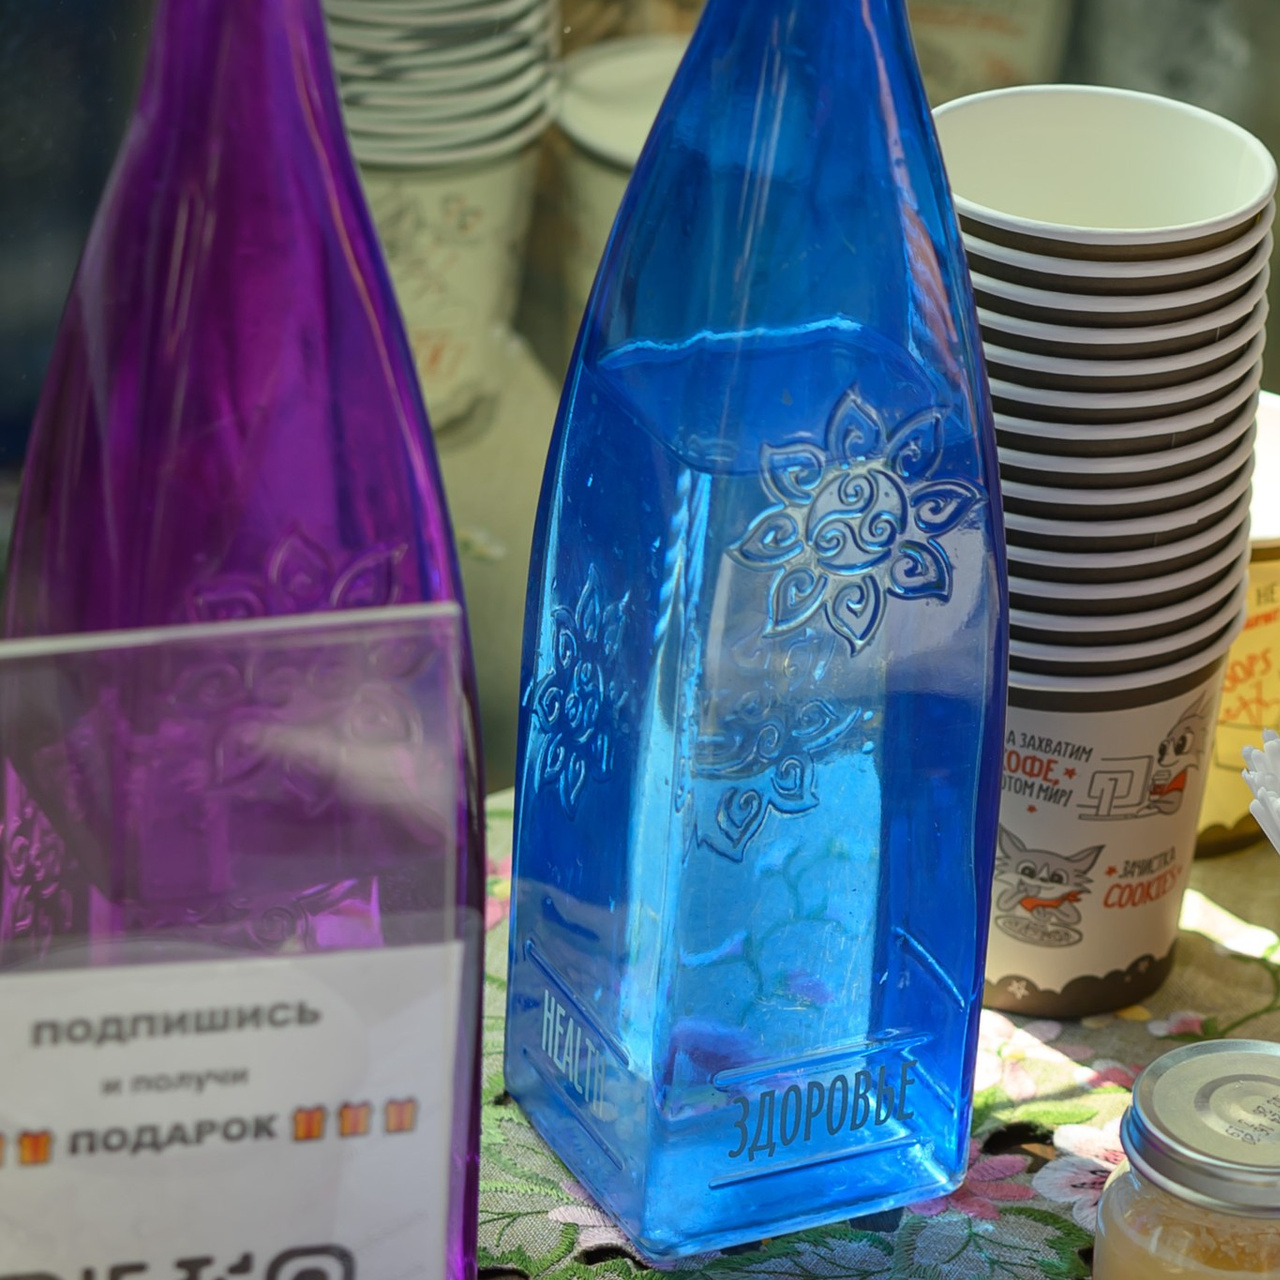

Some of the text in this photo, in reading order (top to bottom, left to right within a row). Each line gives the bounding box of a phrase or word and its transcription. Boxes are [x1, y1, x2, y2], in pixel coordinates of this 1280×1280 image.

[1019, 732, 1094, 763] ЗАХВАТИМ
[1003, 749, 1060, 786] ОФЕ,
[130, 1067, 250, 1098] получи
[728, 1060, 917, 1161] ЗДОРОВЬЕ
[66, 1115, 280, 1158] ПОДАРОК
